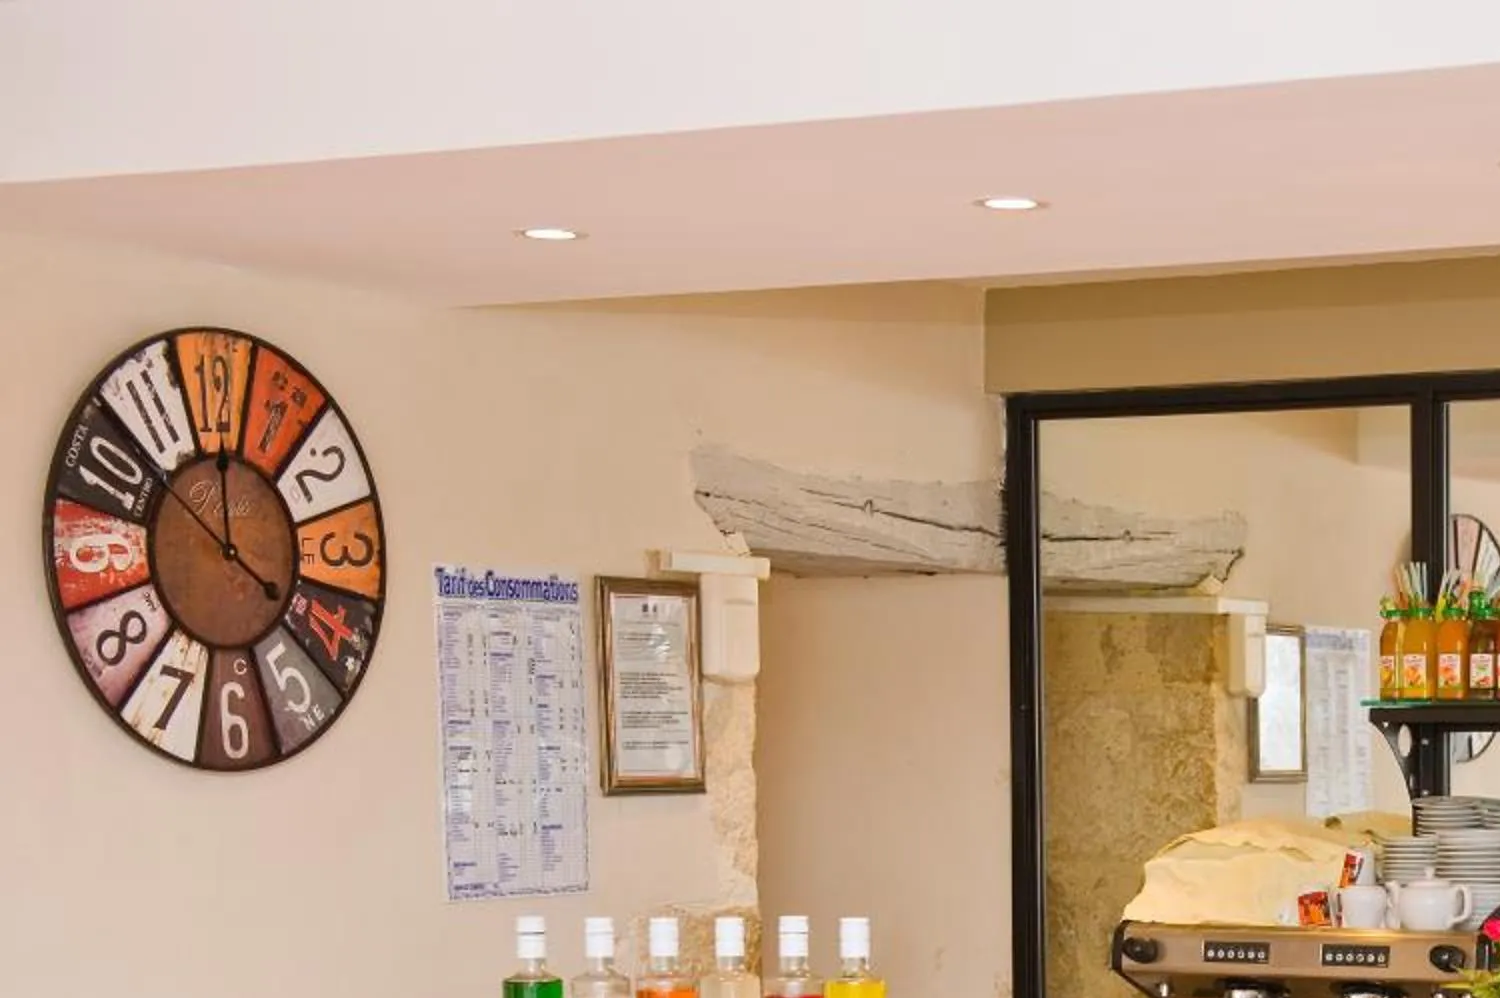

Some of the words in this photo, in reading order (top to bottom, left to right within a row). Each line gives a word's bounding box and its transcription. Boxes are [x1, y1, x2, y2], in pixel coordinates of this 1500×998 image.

[195, 355, 231, 432] 12
[65, 423, 89, 467] COSTA
[258, 400, 288, 453] 1
[79, 436, 143, 511] 10
[295, 444, 346, 504] 2
[69, 534, 134, 573] 9
[320, 532, 374, 567] 3
[435, 567, 466, 598] Tarif
[468, 577, 485, 597] des
[485, 570, 579, 603] Consommations
[96, 610, 147, 666] 8
[309, 598, 353, 662] 4
[151, 664, 195, 730] 7
[265, 641, 312, 713] 5
[220, 682, 249, 760] 6
